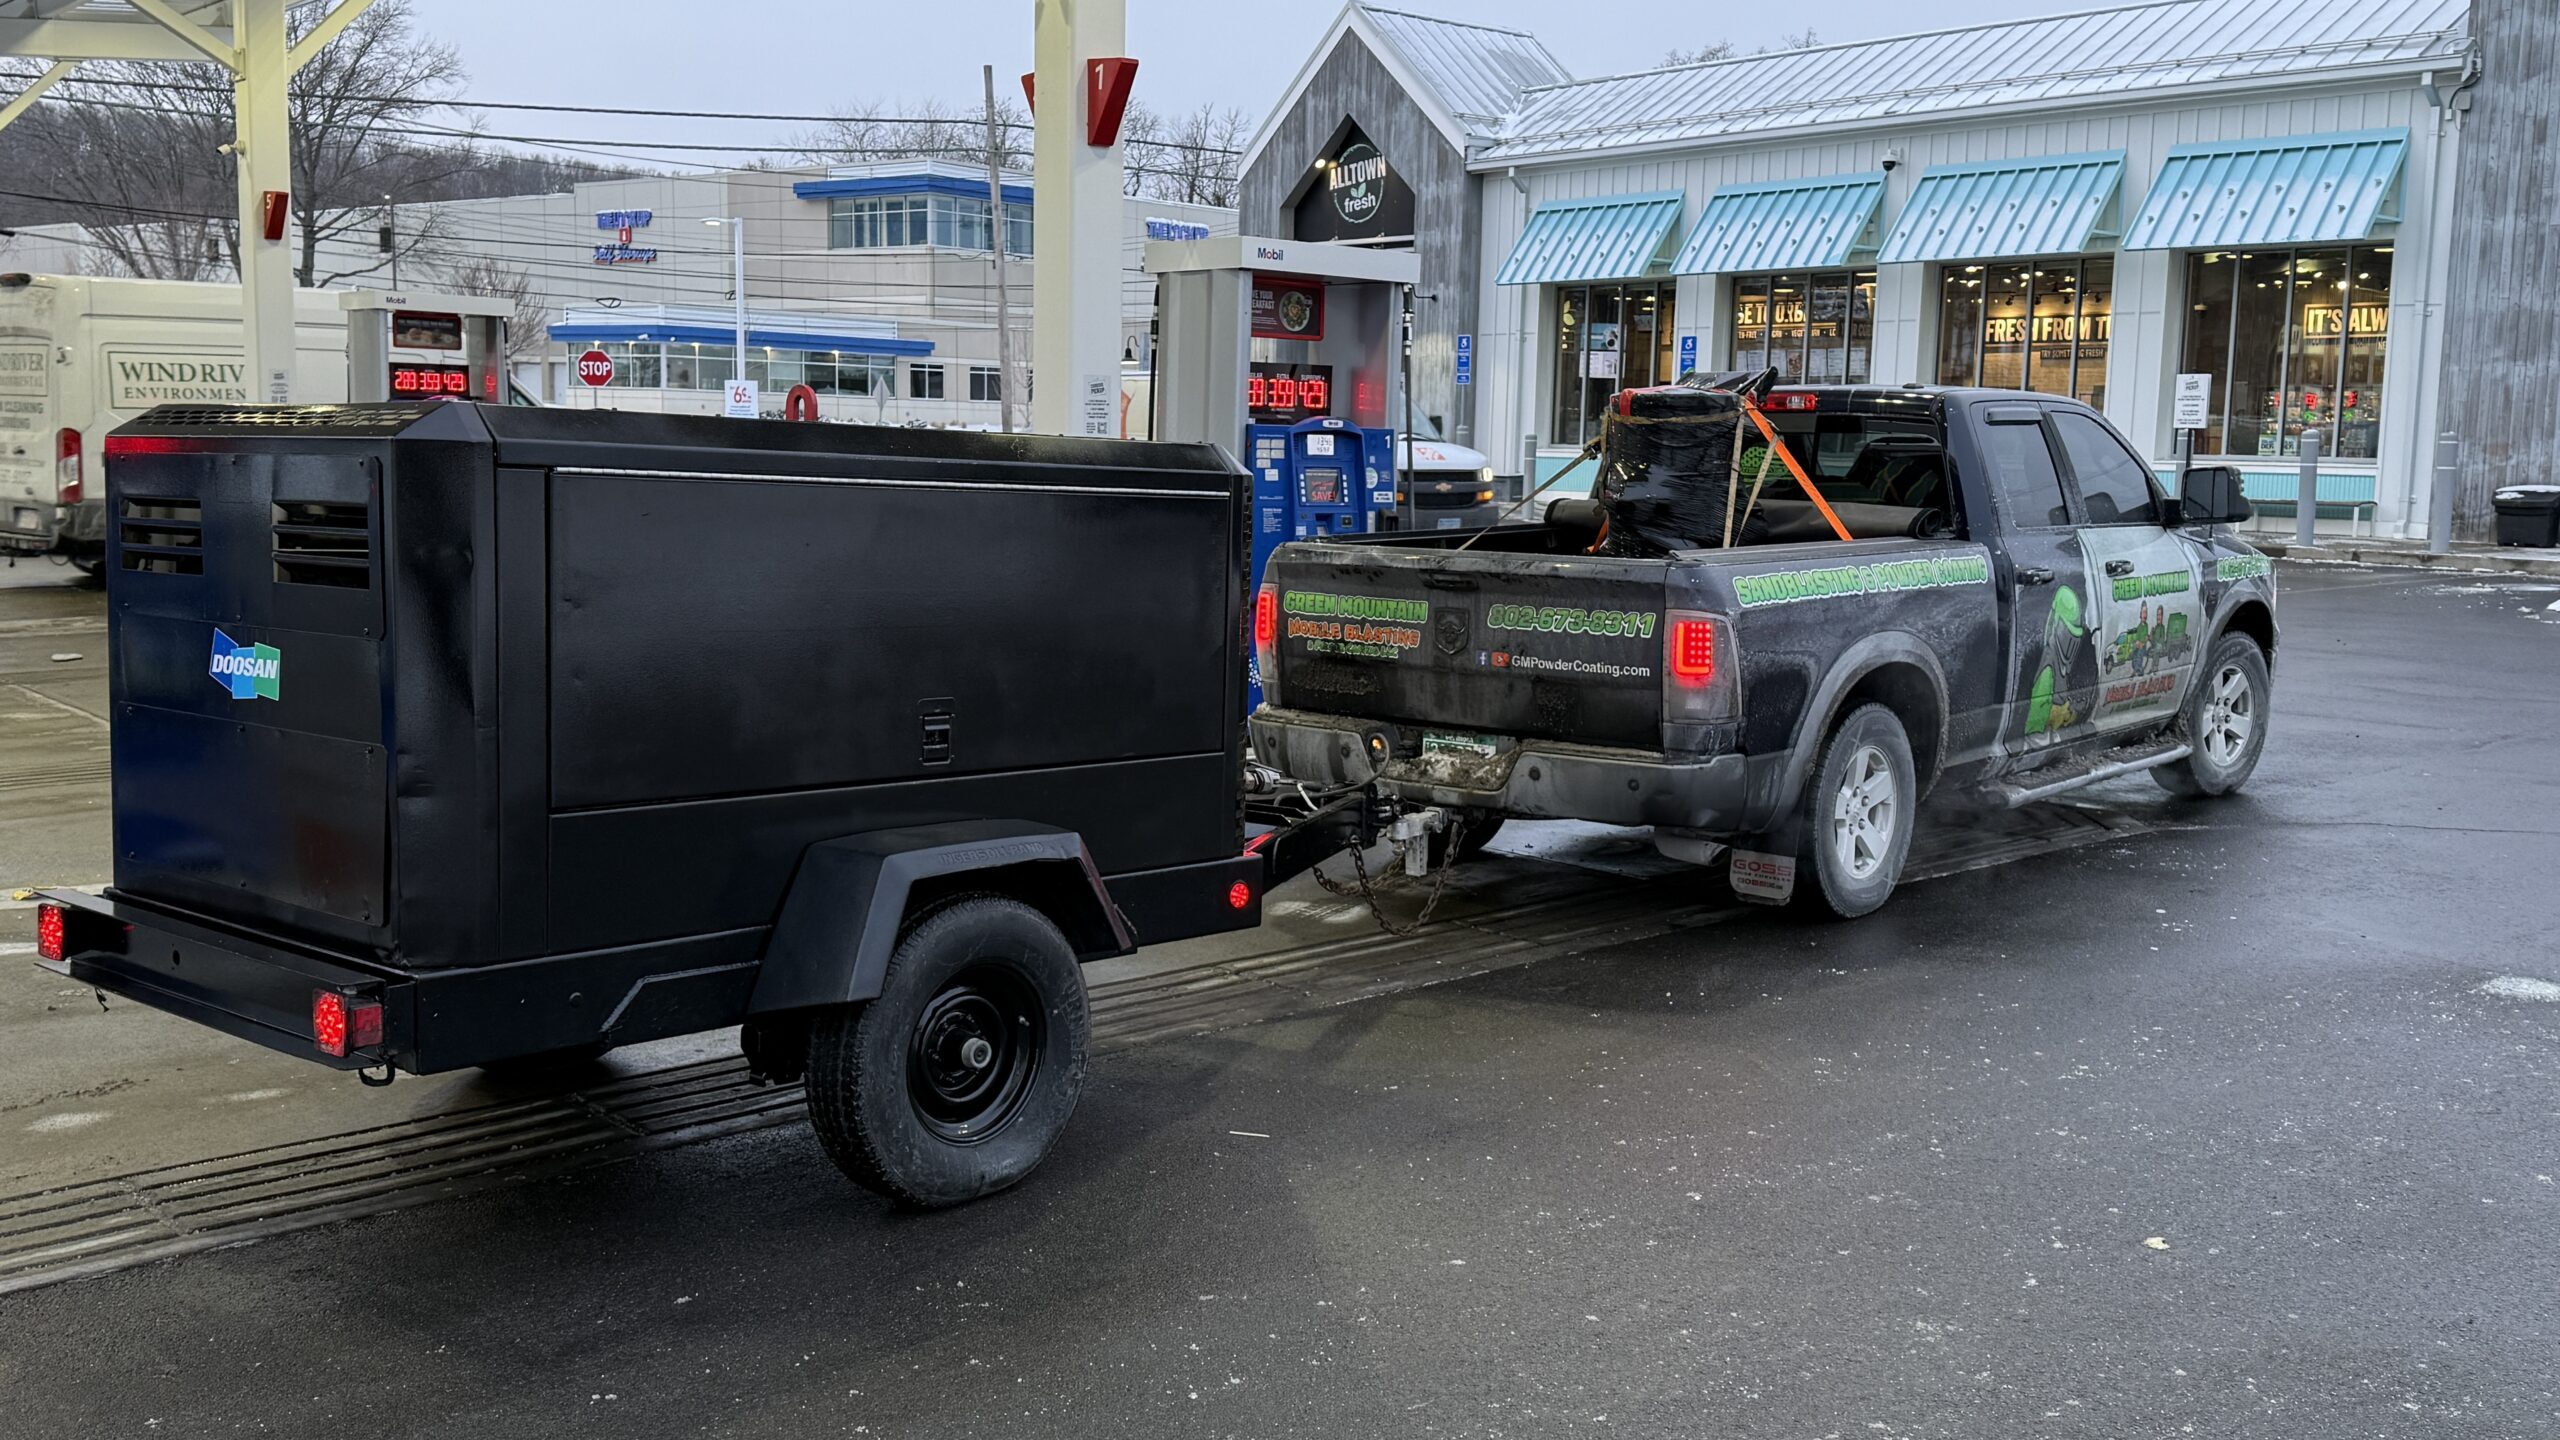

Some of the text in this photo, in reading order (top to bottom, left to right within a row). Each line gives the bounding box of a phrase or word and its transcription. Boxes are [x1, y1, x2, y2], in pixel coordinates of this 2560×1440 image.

[1095, 64, 1104, 90] 1
[1329, 154, 1386, 191] ALLTOWN
[266, 194, 271, 209] 5
[1344, 192, 1376, 213] fresh
[1258, 247, 1283, 260] Mobil
[386, 296, 407, 304] Mobil
[2308, 308, 2388, 333] IT'S ALW
[119, 361, 196, 382] WIND
[580, 361, 611, 376] STOP
[124, 386, 247, 400] ENVIRONMEN
[1385, 435, 1391, 449] 1
[1734, 567, 1863, 606] SANDBLASTING
[1872, 560, 1936, 591] POWDER
[1933, 555, 1987, 586] COATING
[2112, 570, 2189, 602] GREEN MOUNTAIN
[1284, 590, 1428, 623] GREEN MOUNTAIN
[1488, 604, 1656, 638] 802-673-8311
[1289, 617, 1341, 639] MOBILE
[1345, 624, 1420, 649] BLASTING
[212, 654, 278, 679] DOOSAN
[1511, 655, 1650, 677] GMPowderCoating.com
[1733, 859, 1792, 876] GOSS
